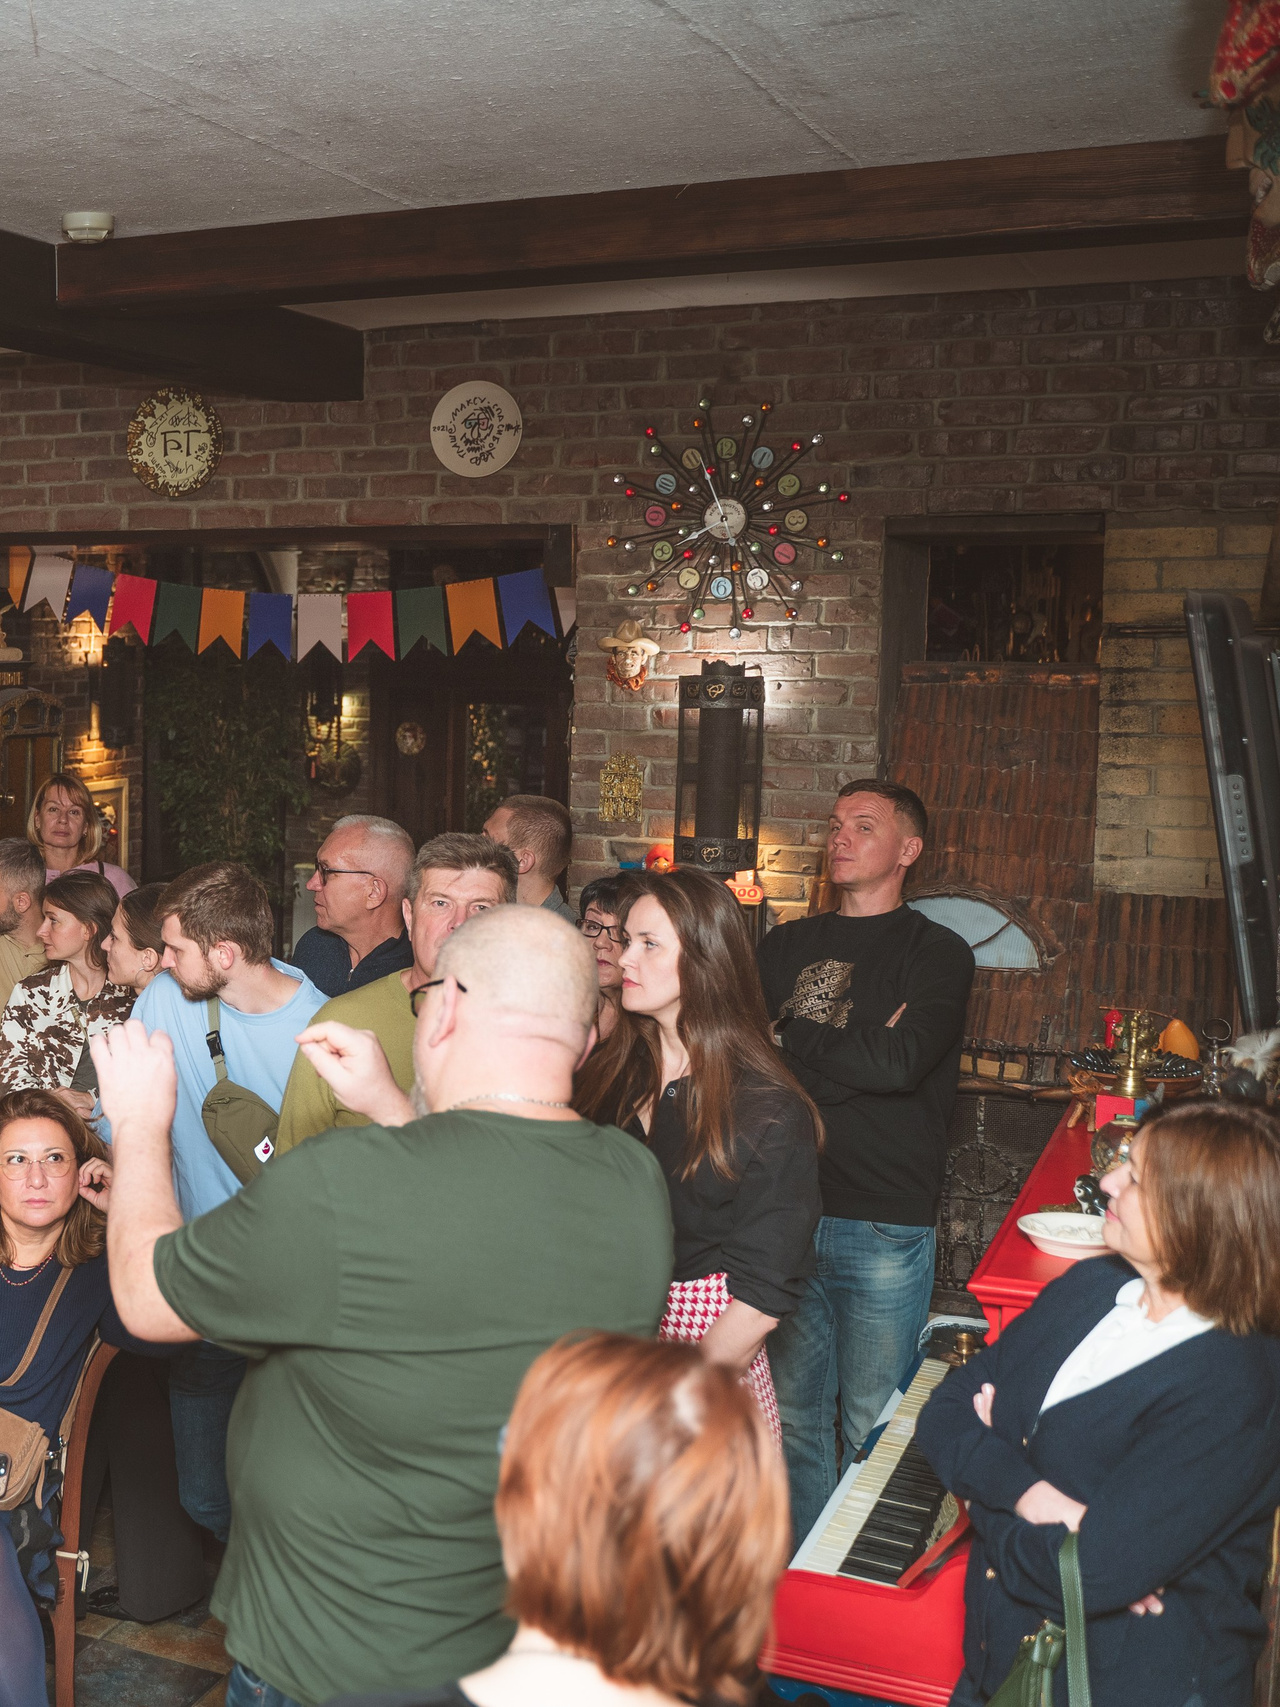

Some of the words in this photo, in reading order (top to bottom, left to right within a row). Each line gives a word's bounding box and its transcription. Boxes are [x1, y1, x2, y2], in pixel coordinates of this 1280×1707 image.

[432, 424, 449, 432] 2021
[721, 441, 733, 457] 12
[686, 451, 700, 468] 11
[757, 451, 768, 465] 1
[658, 477, 675, 492] 10
[780, 479, 797, 492] 2
[788, 515, 805, 526] 3
[654, 544, 670, 558] 8
[683, 569, 696, 586] 7
[750, 571, 764, 587] 5
[715, 581, 727, 597] 6
